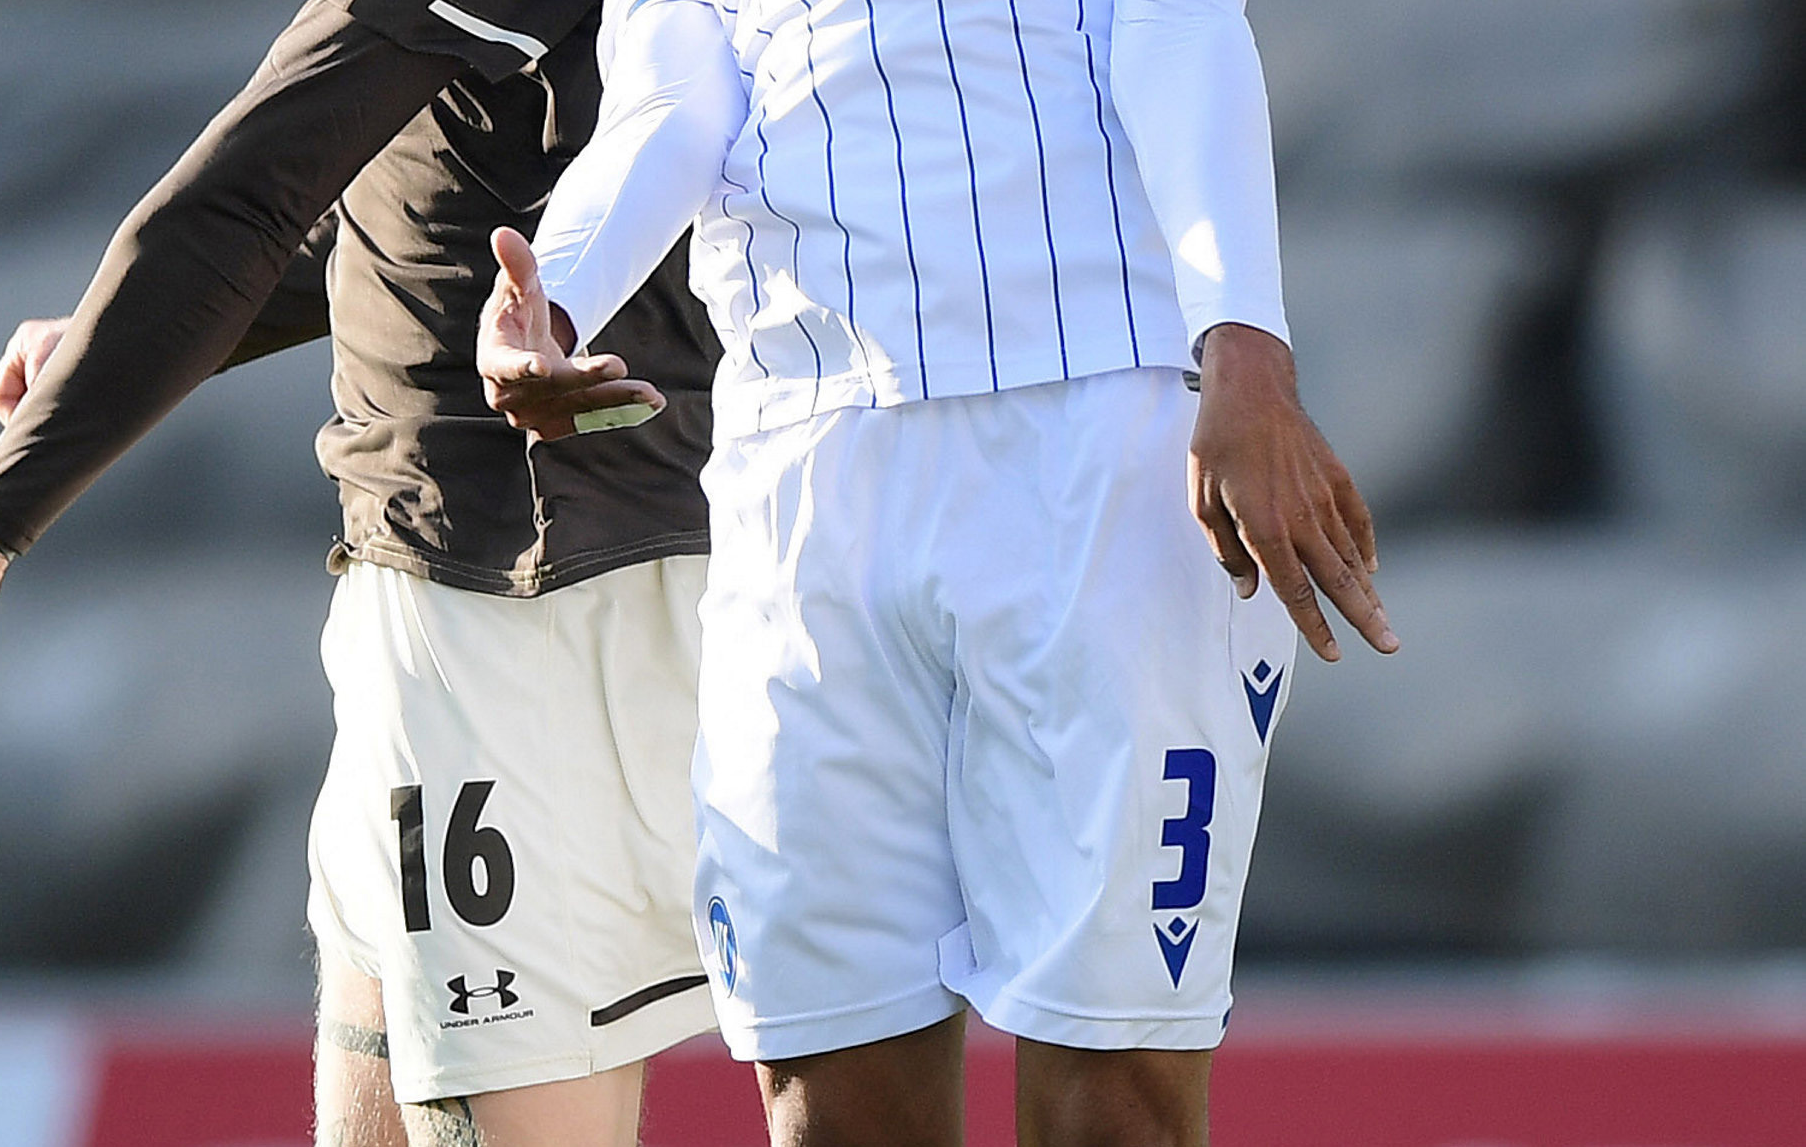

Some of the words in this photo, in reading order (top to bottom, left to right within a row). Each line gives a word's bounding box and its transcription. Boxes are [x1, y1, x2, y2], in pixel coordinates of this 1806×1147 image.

[390, 779, 515, 934] 16
[1151, 748, 1216, 911] 3
[439, 1018, 480, 1030] UNDER
[482, 1009, 534, 1025] ARMOUR
